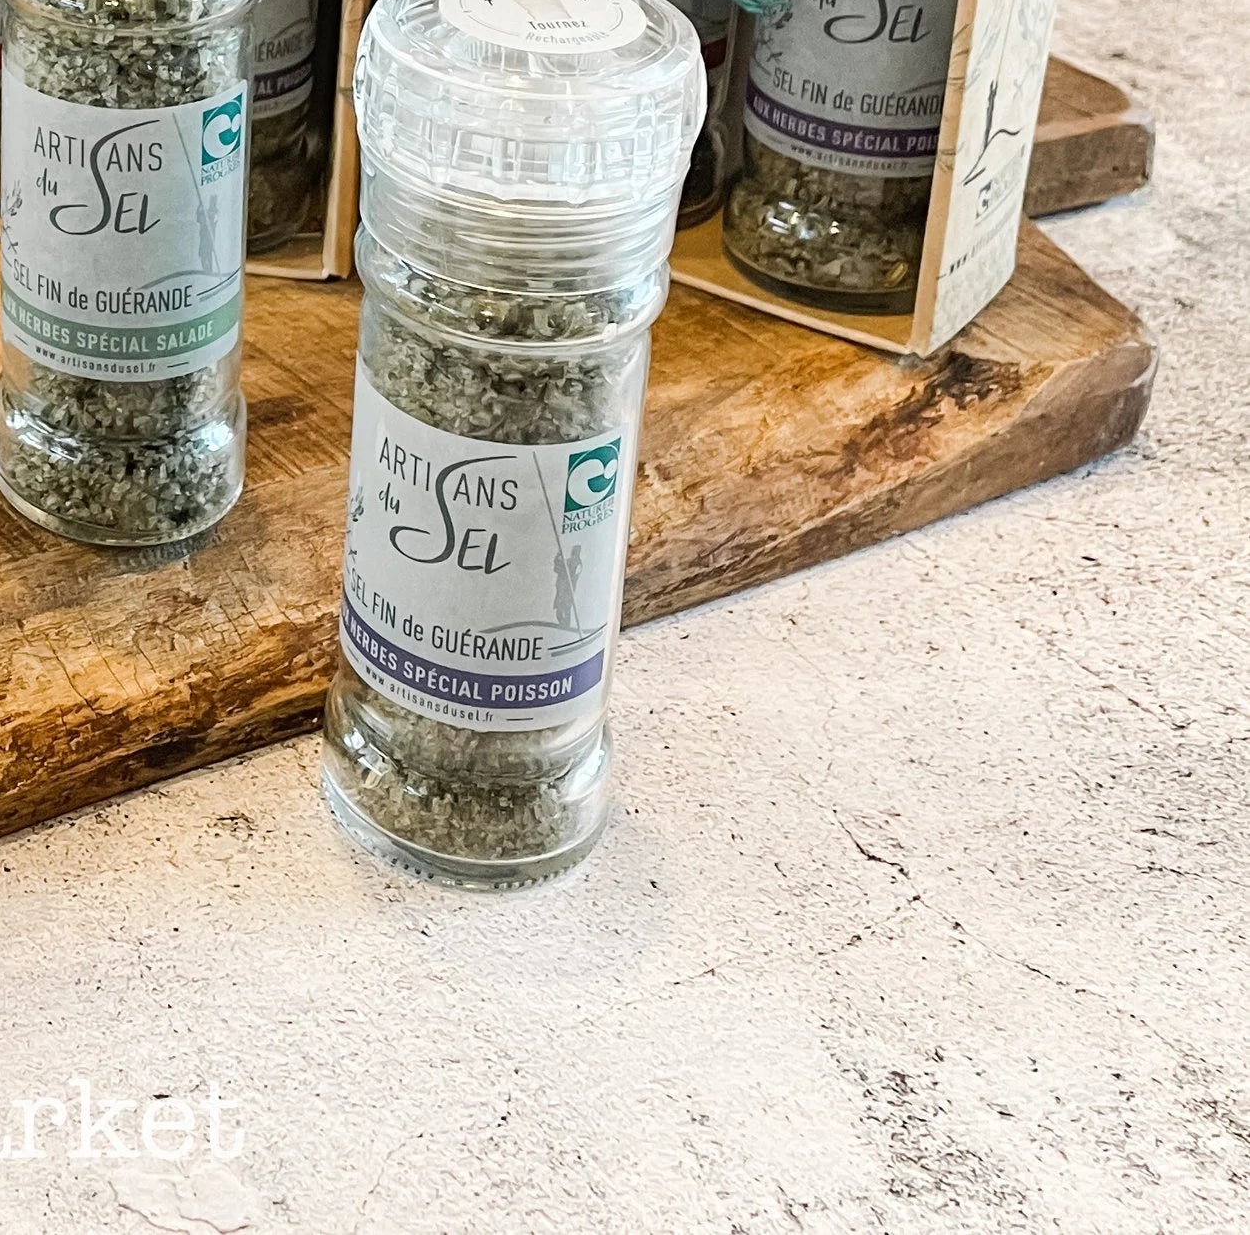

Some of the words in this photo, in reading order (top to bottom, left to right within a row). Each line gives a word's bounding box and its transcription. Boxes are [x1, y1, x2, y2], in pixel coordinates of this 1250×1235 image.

[527, 19, 589, 31] Tournez
[772, 67, 796, 96] SEL
[801, 79, 827, 105] FIN
[833, 90, 854, 112] de
[34, 119, 164, 173] ARTISANS
[773, 108, 826, 141] HERBES
[831, 129, 899, 152] SPÉCIAL
[36, 168, 58, 197] du
[13, 258, 33, 292] SEL
[37, 273, 62, 304] FIN
[68, 286, 89, 312] de
[95, 285, 193, 315] GUÉRANDE
[18, 307, 70, 345] HERBES
[76, 331, 151, 354] SPÉCIAL
[156, 320, 214, 352] SALADE
[35, 345, 157, 374] www.artisansdusel.fr
[379, 436, 519, 511] ARTISANS
[378, 482, 401, 515] du
[350, 567, 369, 609] SEL
[372, 591, 397, 630] FIN
[402, 613, 425, 642] de
[431, 628, 544, 662] GUÉRANDE
[349, 615, 399, 671] HERBES
[403, 661, 484, 702] SPÉCIAL
[491, 675, 574, 703] POISSON
[365, 664, 494, 723] www.artisansdusel.fr
